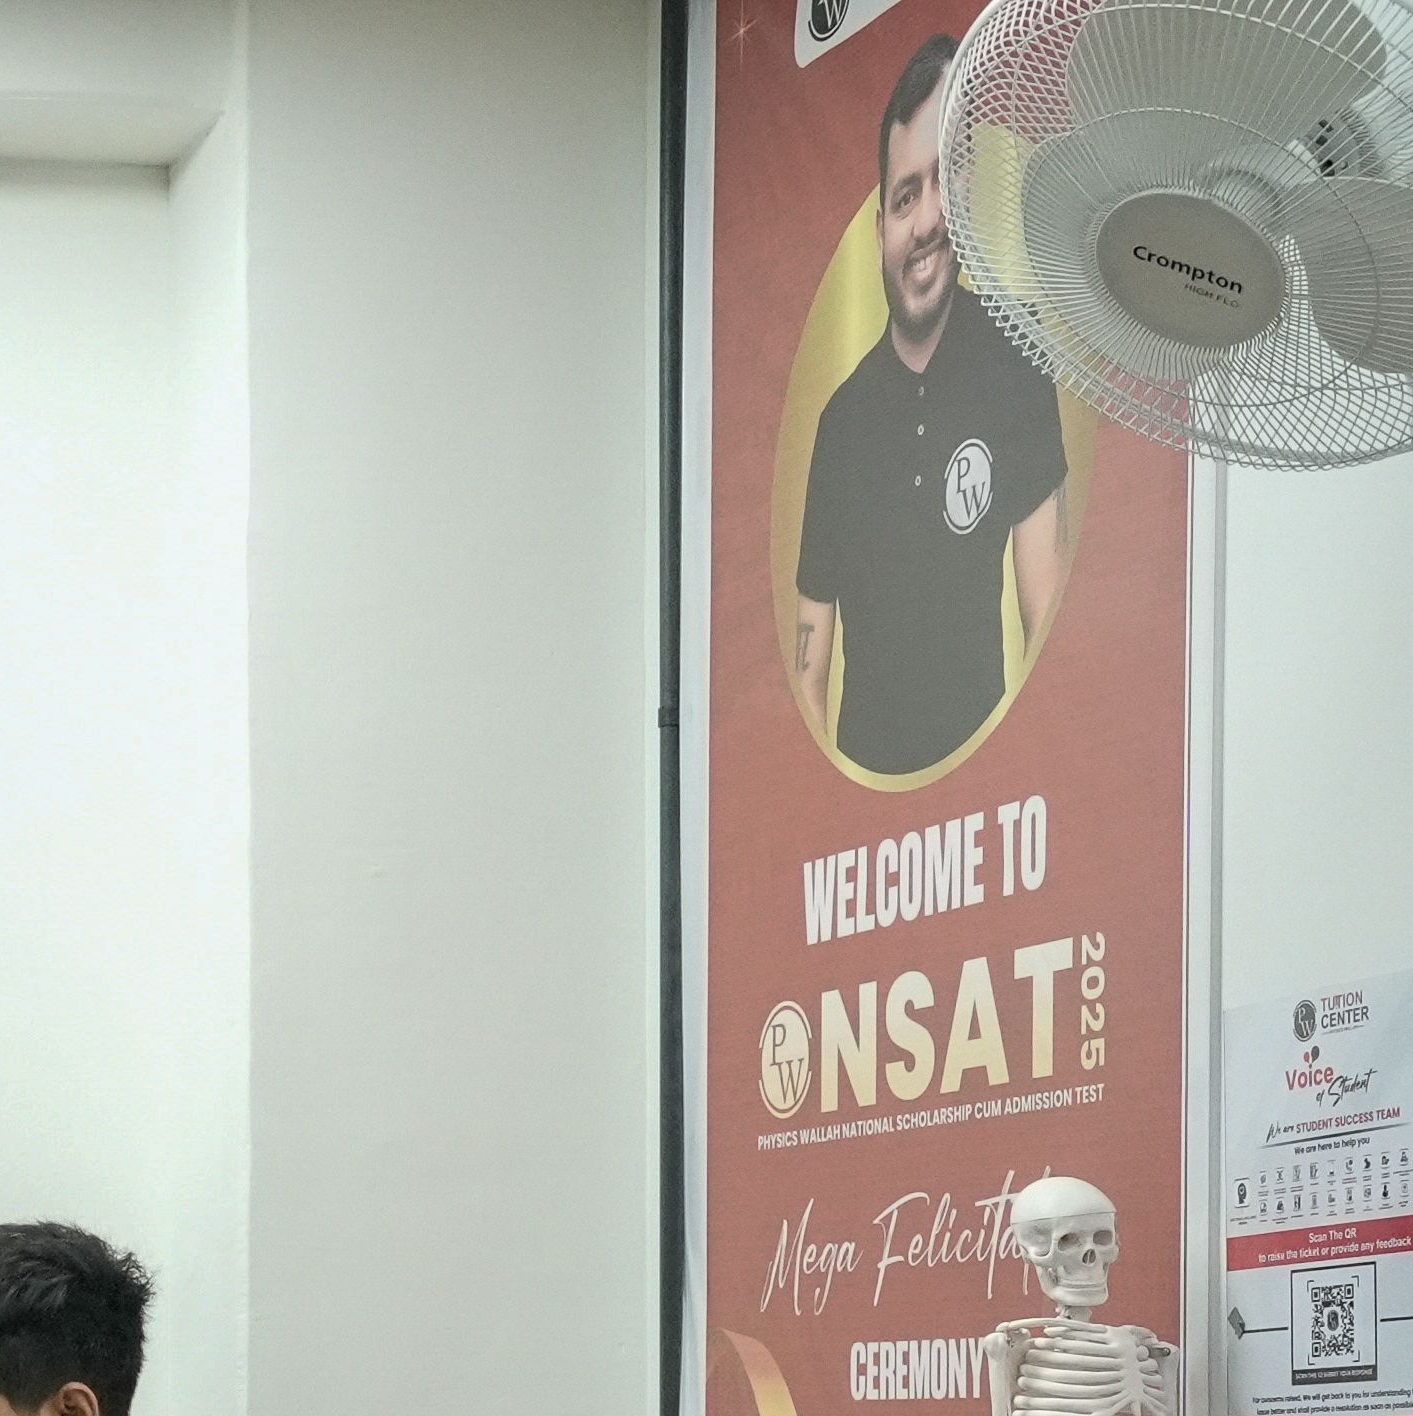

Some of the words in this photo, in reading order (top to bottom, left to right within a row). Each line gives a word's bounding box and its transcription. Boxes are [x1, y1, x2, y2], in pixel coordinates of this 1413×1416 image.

[1132, 245, 1244, 294] Crompton
[803, 811, 984, 945] WELCOME
[997, 794, 1047, 897] TO
[1080, 931, 1106, 1071] 2025
[1320, 989, 1363, 1012] TUITION
[1321, 1006, 1370, 1029] CENTER
[820, 937, 1073, 1113] NSAT
[1285, 1064, 1335, 1091] Voice
[1327, 1068, 1378, 1107] Student
[757, 1130, 798, 1151] PHYSICS
[799, 1125, 841, 1145] WALLAH
[842, 1118, 895, 1138] NATIONAL
[896, 1104, 973, 1131] SCHOLARSHIP
[974, 1099, 1002, 1120] CUM
[1004, 1088, 1073, 1116] ADMISSION
[1075, 1083, 1106, 1105] TEST
[1296, 1117, 1334, 1134] STUDENT
[1334, 1110, 1374, 1128] SUCCESS
[1376, 1106, 1401, 1121] TEAM
[759, 1197, 864, 1316] Mega
[872, 1166, 1051, 1307] Felicita
[1308, 1231, 1328, 1244] Scan
[1329, 1229, 1344, 1241] The
[1344, 1227, 1357, 1239] QR
[1330, 1241, 1359, 1256] provide
[1376, 1235, 1412, 1249] feedback
[849, 1337, 984, 1401] CEREMONY
